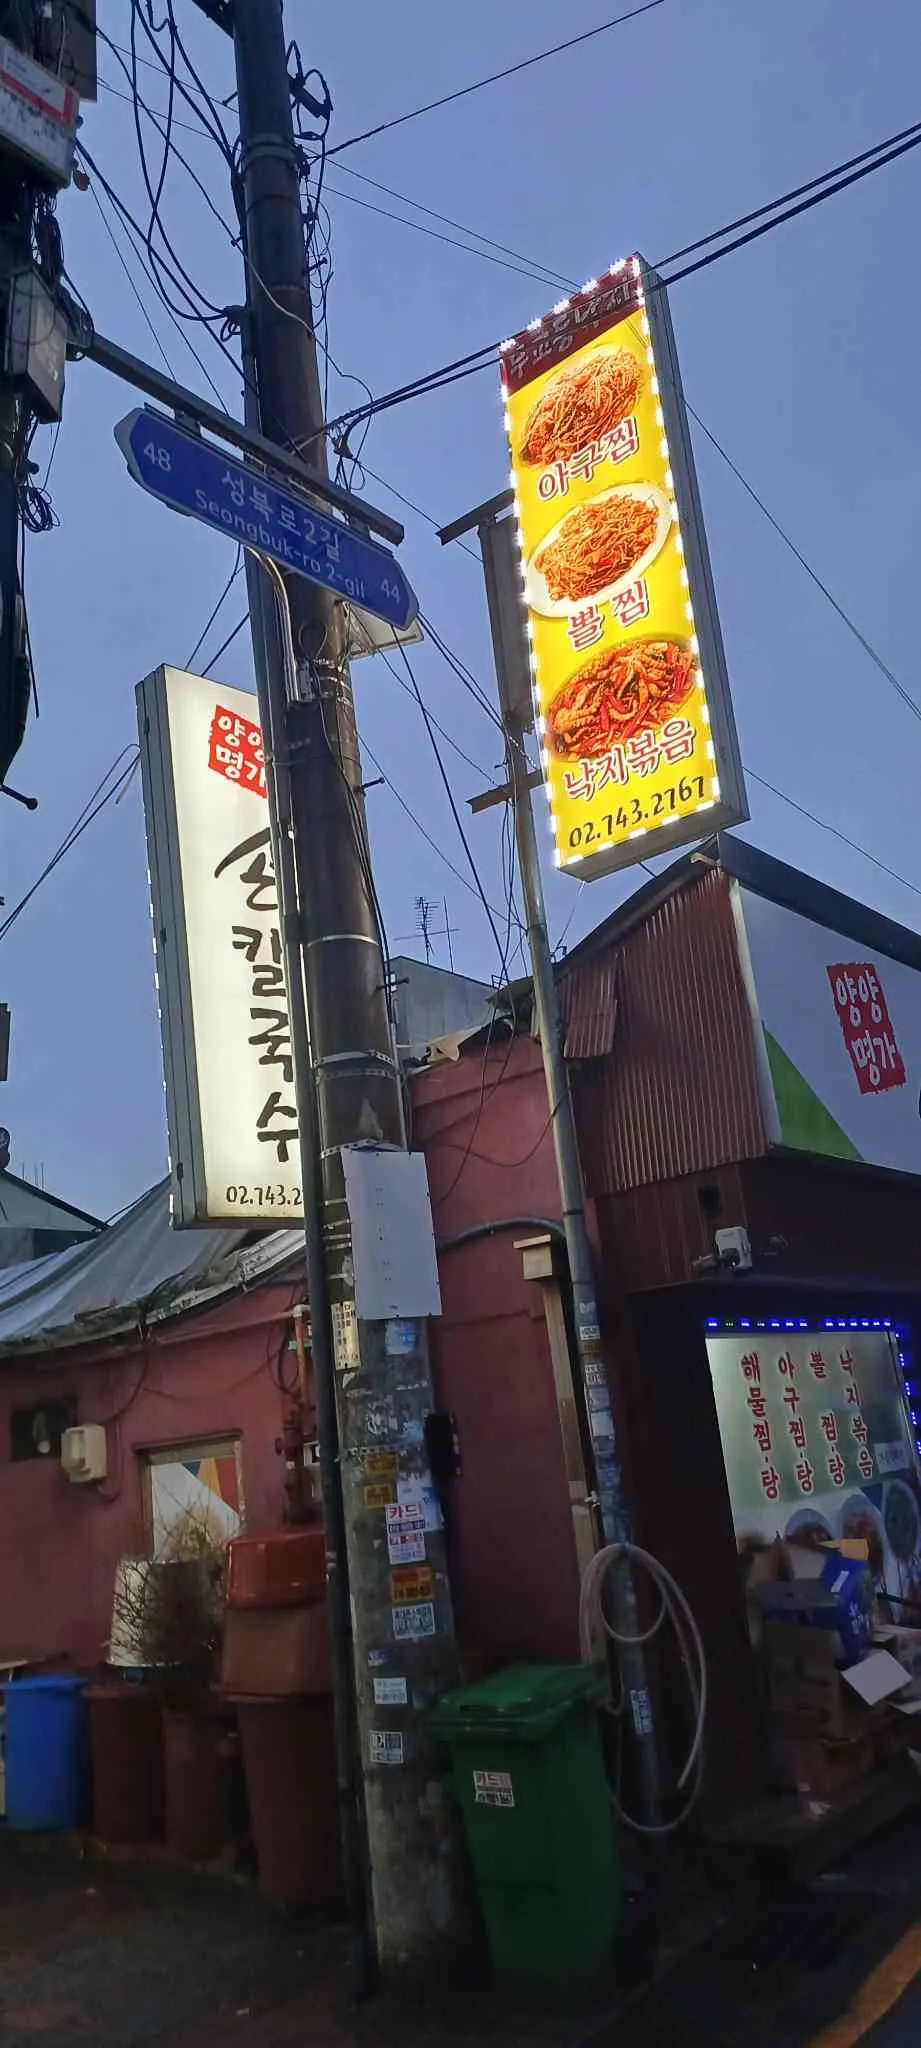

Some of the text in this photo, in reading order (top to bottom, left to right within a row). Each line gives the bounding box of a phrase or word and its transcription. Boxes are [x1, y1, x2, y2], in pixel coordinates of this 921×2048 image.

[143, 441, 171, 473] 48
[538, 417, 636, 499] 아구찜
[195, 489, 366, 599] Seongbuk-ro 2-gil
[222, 470, 342, 563] 성북로2길
[380, 577, 401, 604] 44
[568, 579, 647, 650] 뽈 찜
[564, 720, 695, 800] 낙지볶음
[569, 776, 705, 847] 02.743.2767
[835, 969, 883, 1027] 양양
[851, 1029, 897, 1086] 명가
[226, 1184, 303, 1206] 02.743.2
[839, 1350, 873, 1478] 낙지볶음
